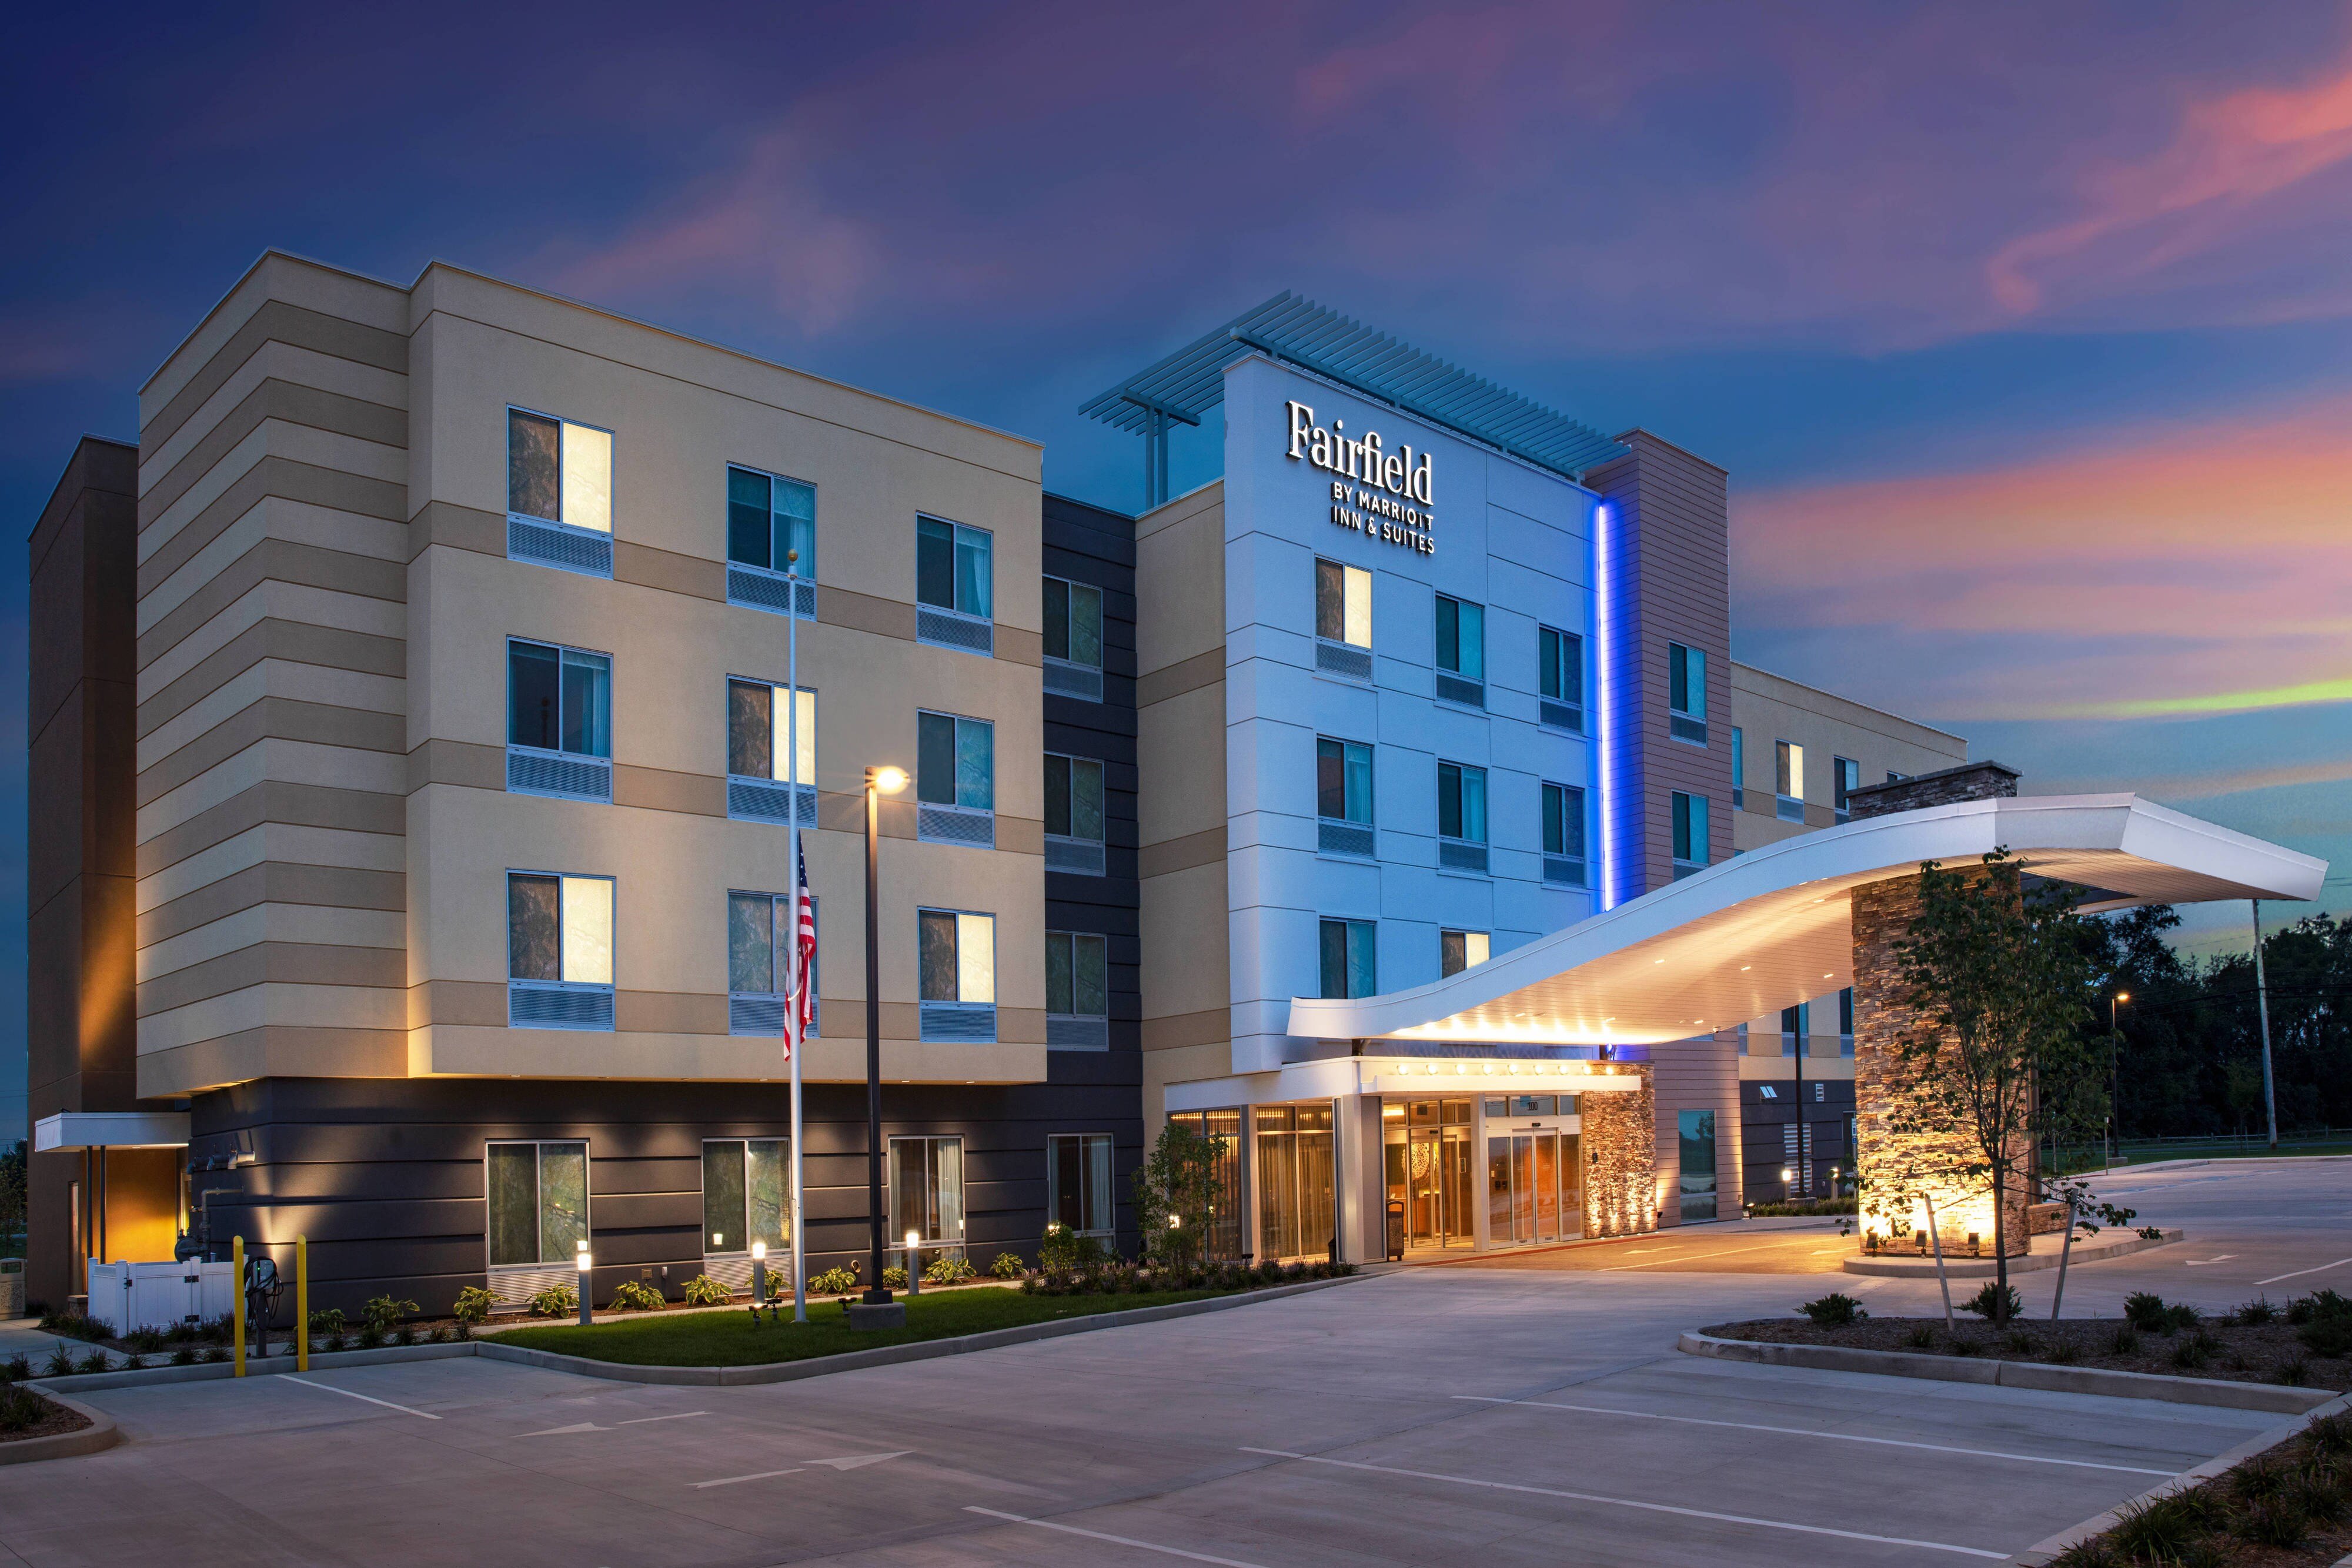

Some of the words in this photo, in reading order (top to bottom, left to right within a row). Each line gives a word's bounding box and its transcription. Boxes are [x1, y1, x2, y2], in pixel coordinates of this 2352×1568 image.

[1287, 400, 1434, 506] Fairfield
[1332, 482, 1352, 503] BY
[1358, 490, 1434, 531] MARRIOTT
[1333, 505, 1361, 530] INN
[1367, 516, 1376, 536] &
[1382, 522, 1434, 554] SUITES
[1527, 1101, 1538, 1111] 100
